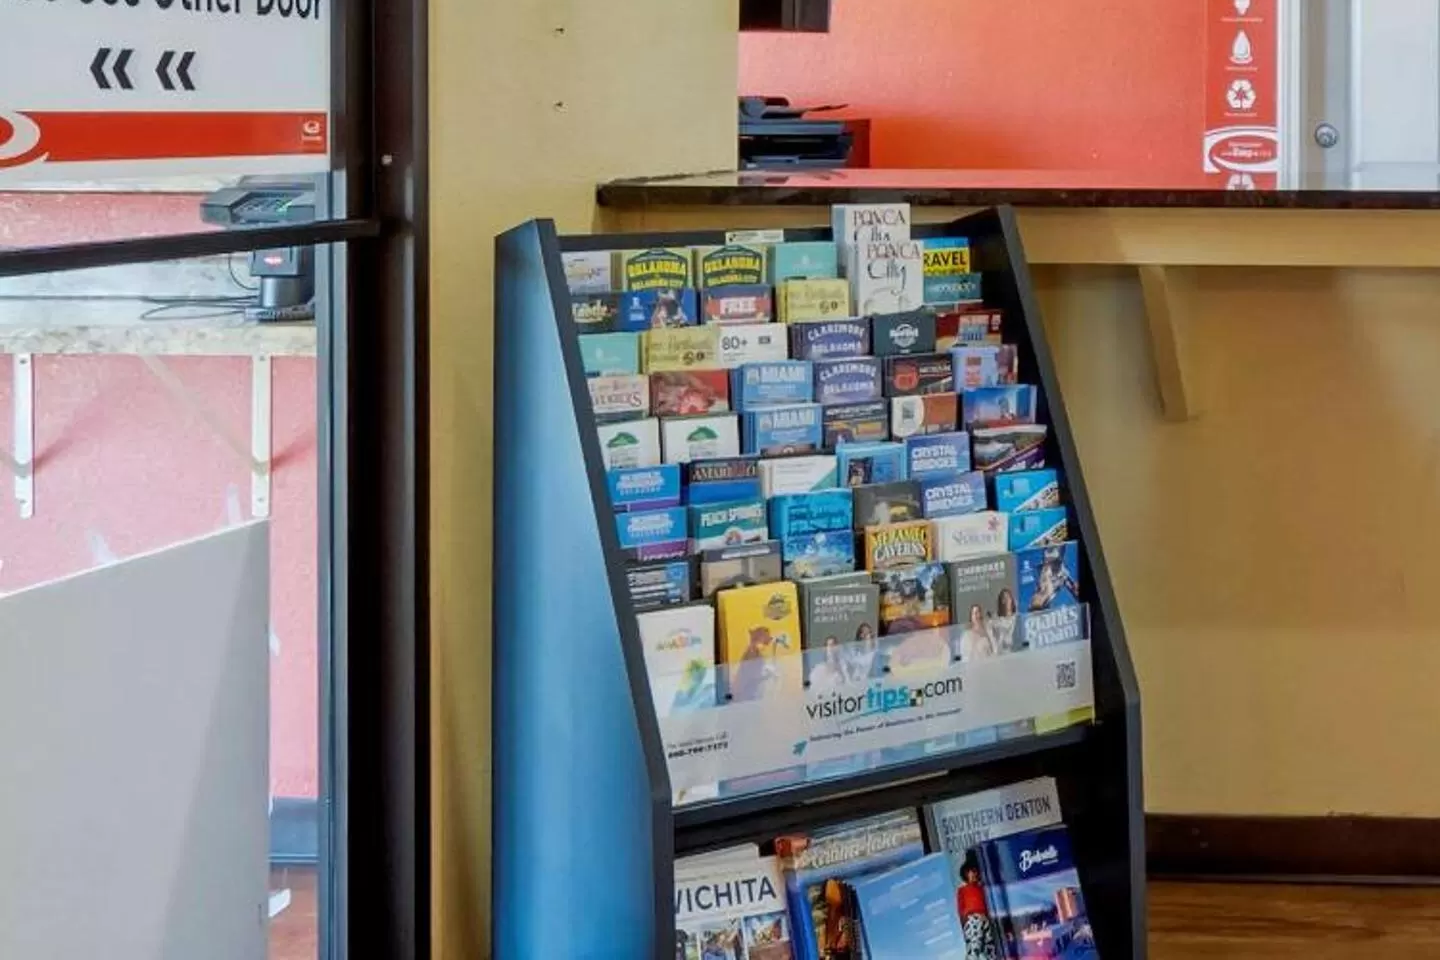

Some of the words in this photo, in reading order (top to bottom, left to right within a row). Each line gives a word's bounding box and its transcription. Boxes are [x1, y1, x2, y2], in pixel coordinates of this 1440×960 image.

[853, 208, 907, 227] PONCA
[867, 243, 922, 261] PONCA
[720, 297, 757, 314] FREE
[808, 323, 864, 341] CLAREMORE
[819, 363, 876, 382] CLAREMORE
[911, 444, 957, 459] CRYSTAL
[873, 540, 926, 562] CAVERNS
[942, 809, 1004, 835] SOUTHERN
[1005, 795, 1051, 822] DENTON
